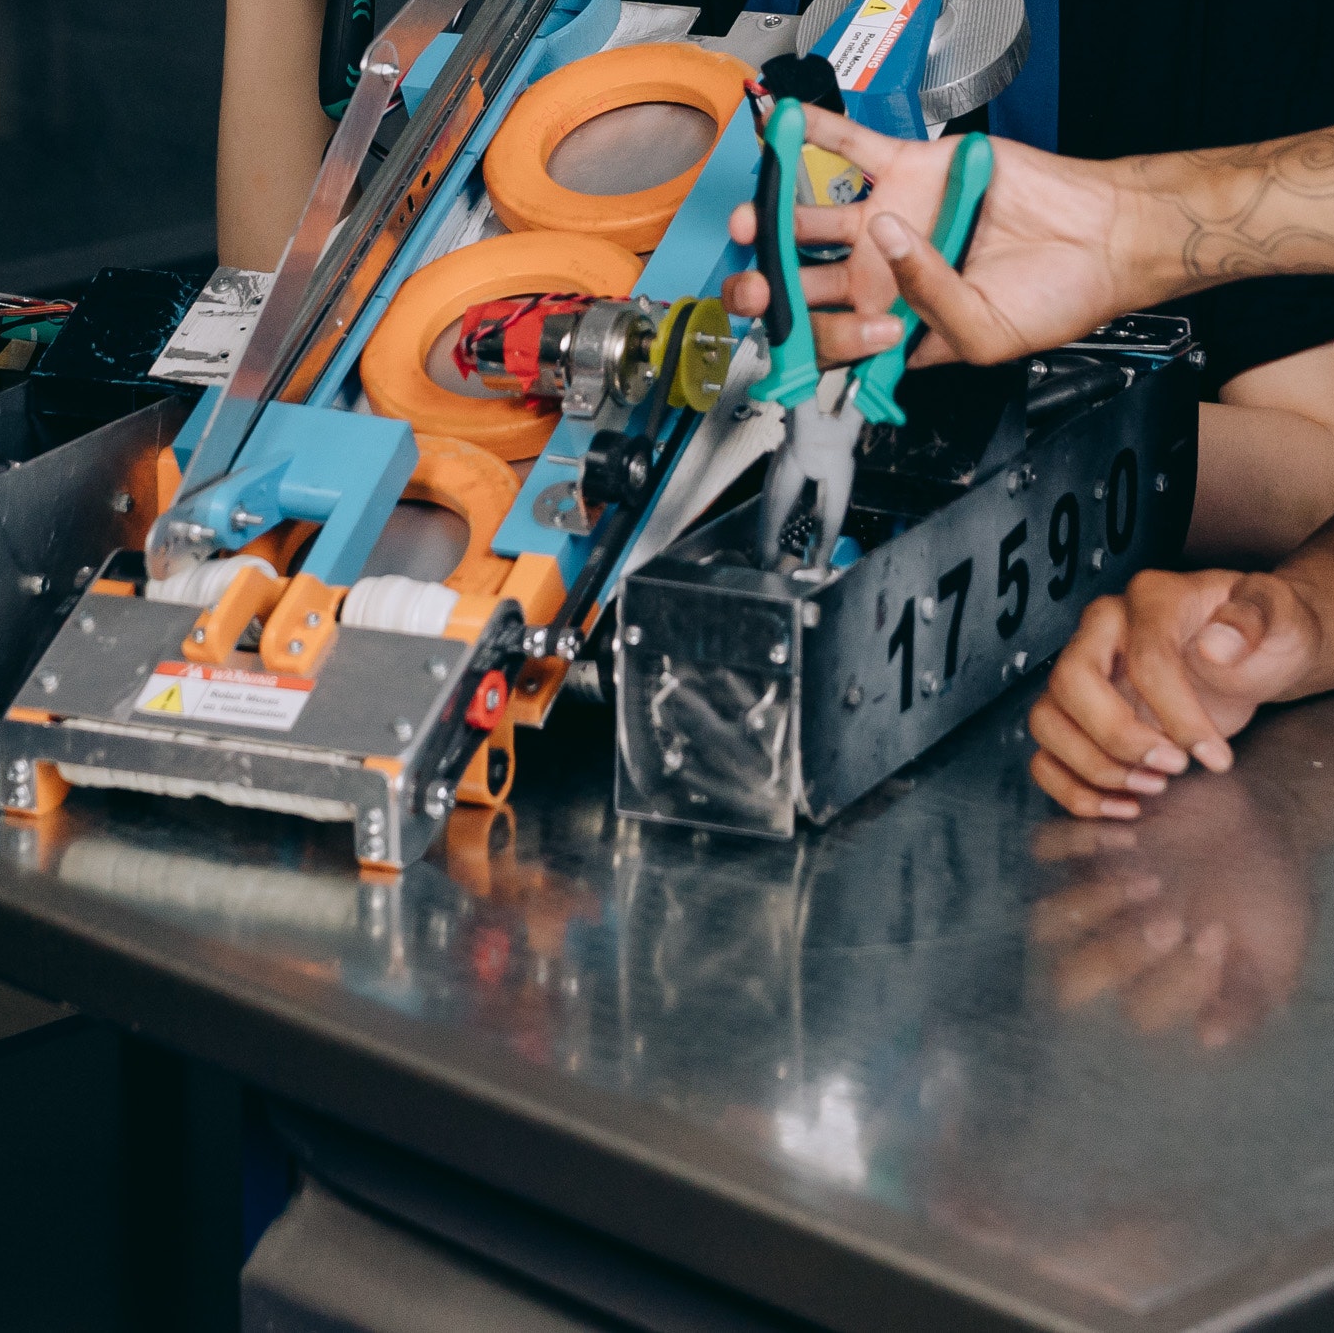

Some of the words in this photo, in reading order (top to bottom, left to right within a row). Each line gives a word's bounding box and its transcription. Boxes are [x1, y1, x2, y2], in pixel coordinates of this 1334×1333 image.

[860, 33, 875, 54] Robot
[867, 24, 905, 69] WARNING
[841, 55, 862, 77] Moves
[888, 447, 1138, 714] 17590
[211, 669, 279, 686] WARNING
